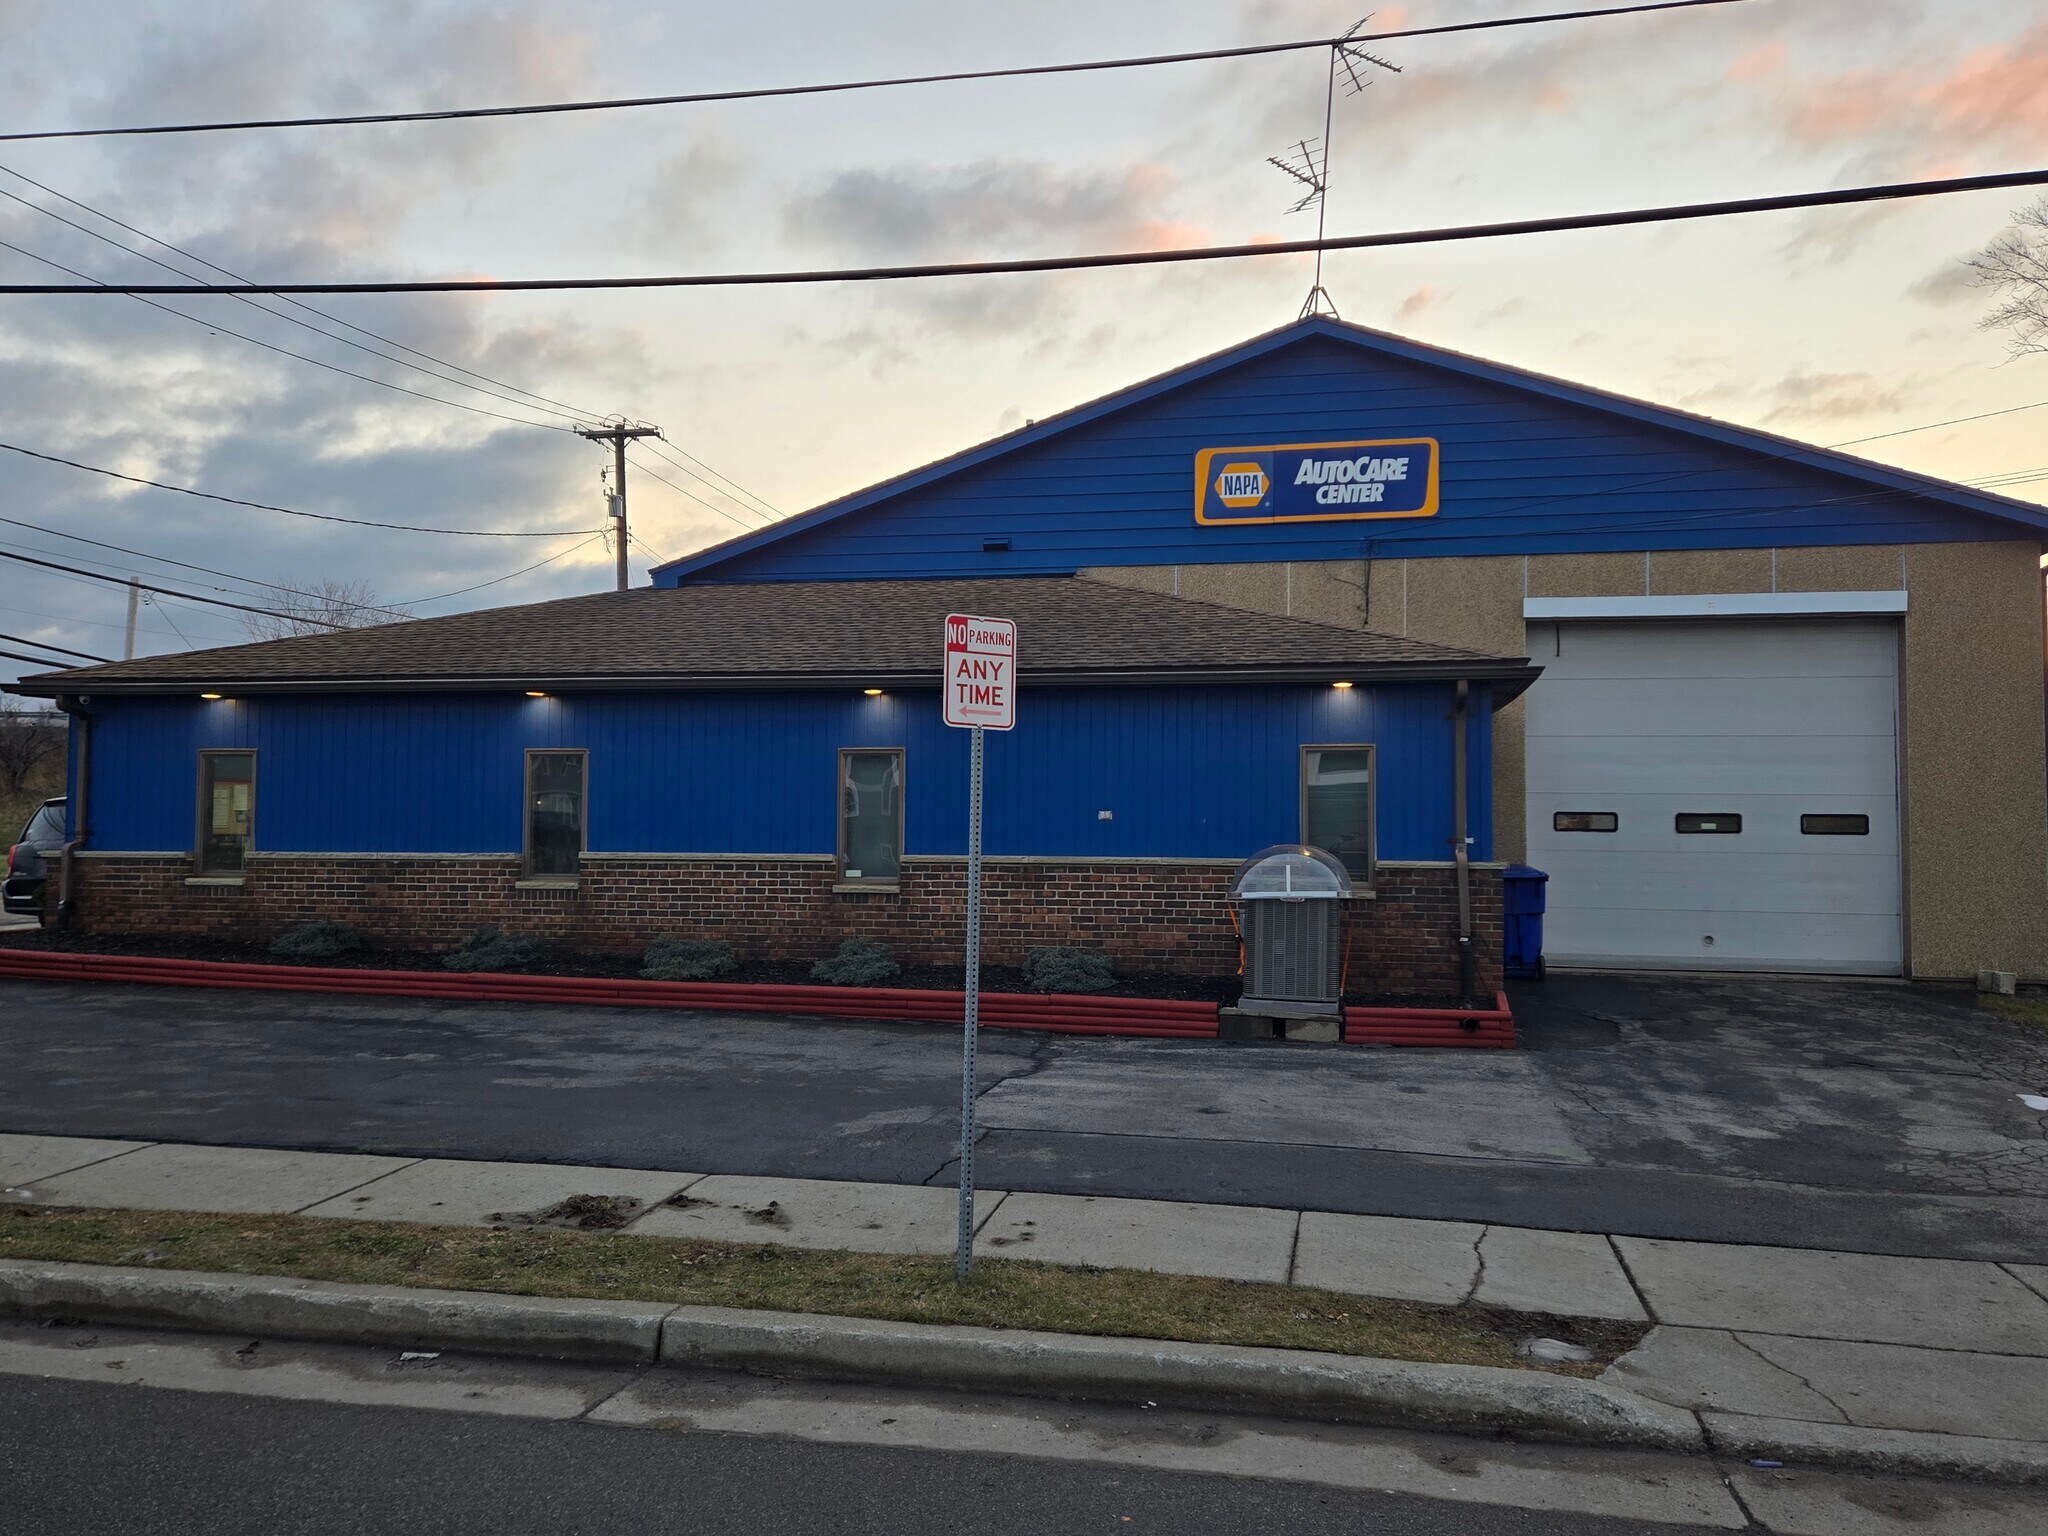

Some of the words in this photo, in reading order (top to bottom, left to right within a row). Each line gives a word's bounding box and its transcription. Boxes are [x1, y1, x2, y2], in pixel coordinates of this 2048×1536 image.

[1224, 475, 1260, 496] NAPA
[1316, 483, 1384, 504] CENTER
[948, 623, 966, 645] NO
[969, 629, 1011, 646] PARKING
[956, 658, 1004, 681] ANY
[956, 683, 1004, 706] TIME
